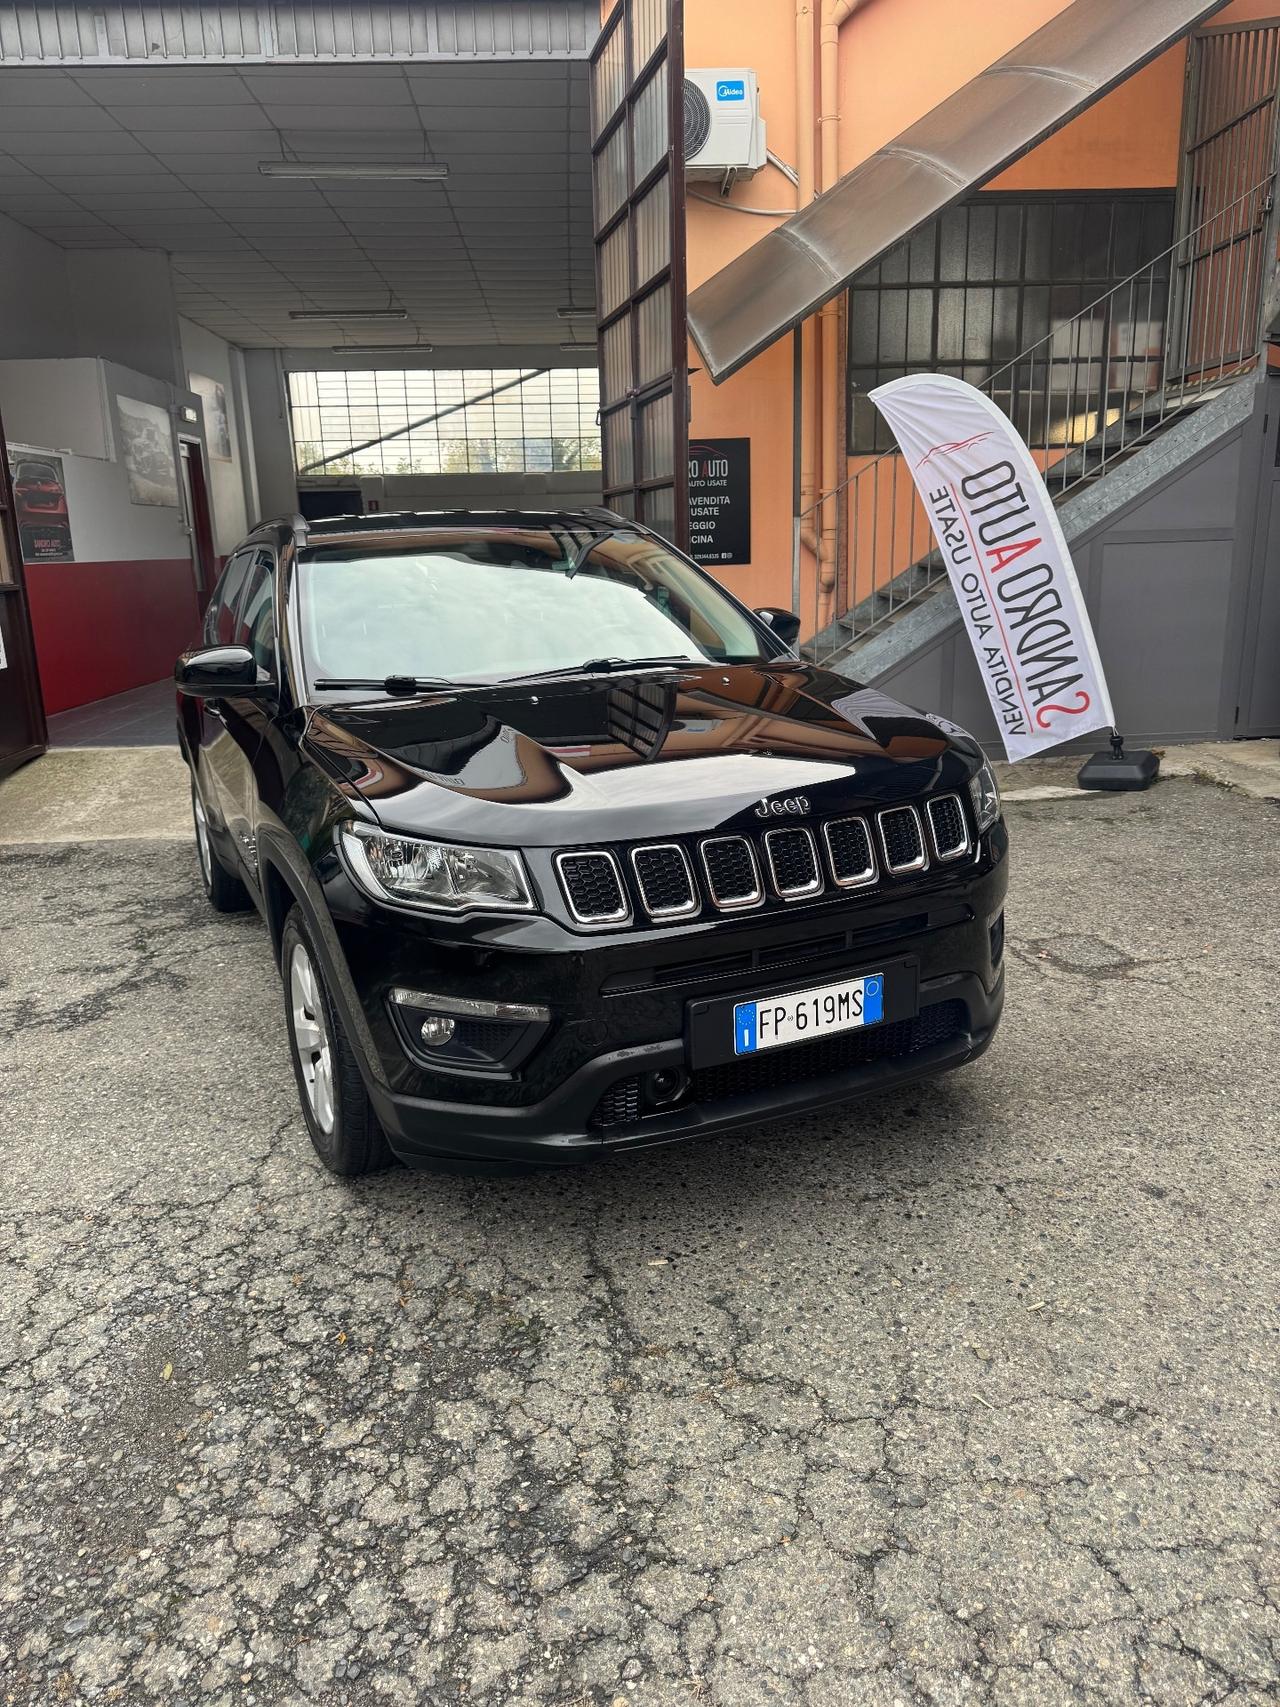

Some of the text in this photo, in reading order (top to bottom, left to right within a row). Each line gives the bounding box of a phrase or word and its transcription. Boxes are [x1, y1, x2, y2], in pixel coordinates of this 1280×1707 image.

[720, 86, 743, 97] Midea
[701, 460, 729, 478] AUTO
[707, 479, 728, 487] USATE
[691, 507, 720, 516] USATE
[755, 795, 811, 818] Jeep
[759, 1006, 787, 1039] FP
[795, 989, 863, 1030] 619MS
